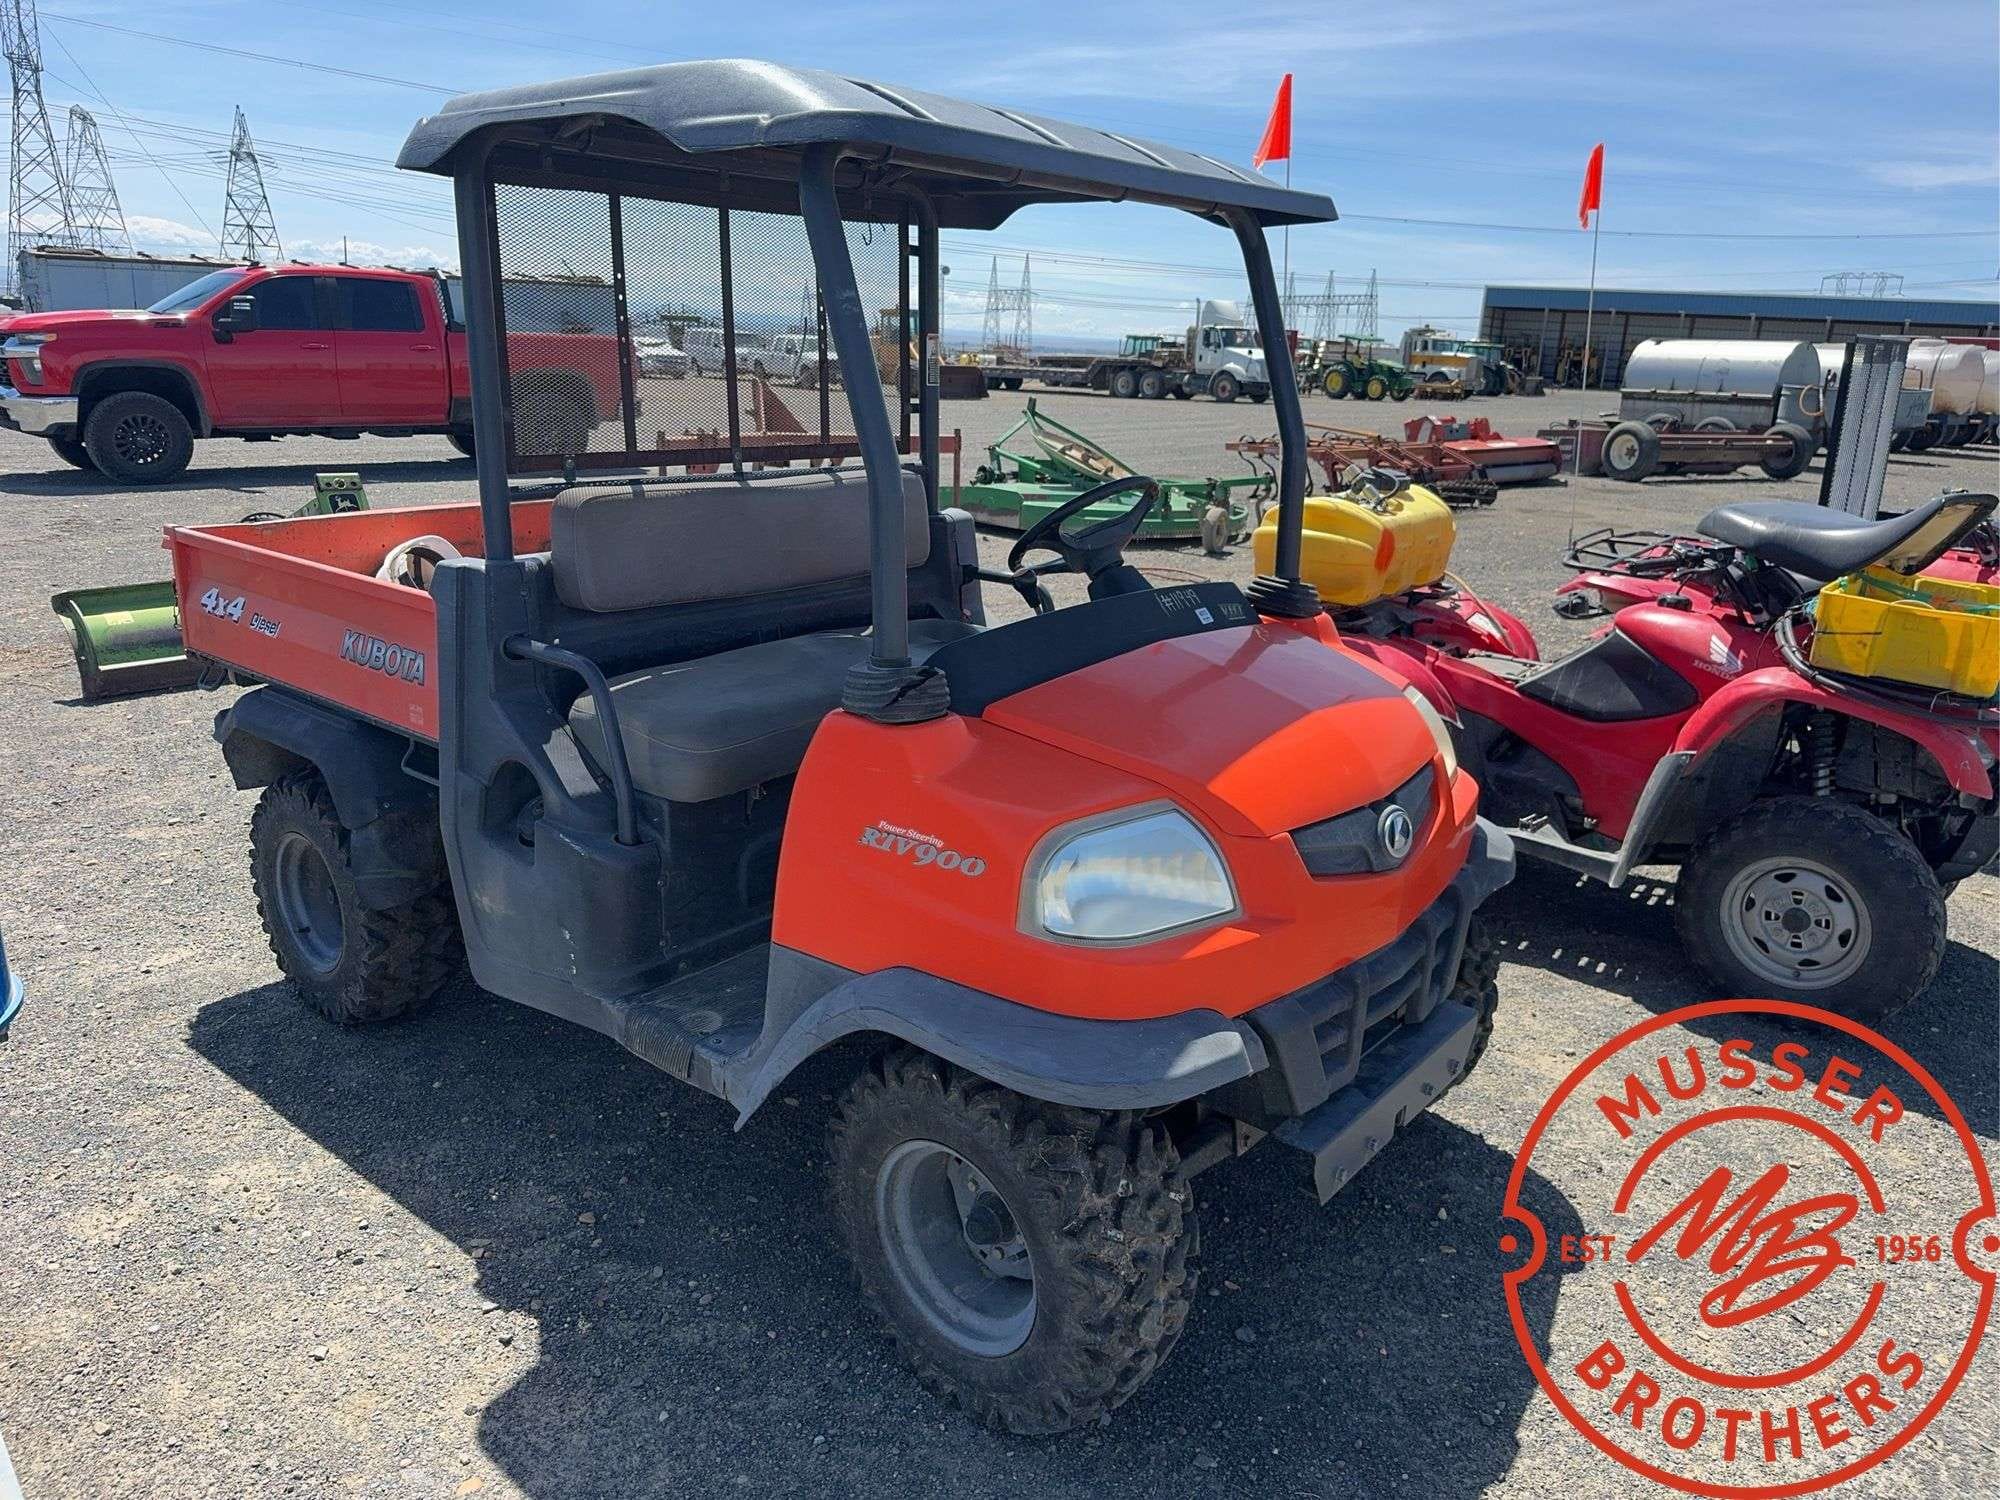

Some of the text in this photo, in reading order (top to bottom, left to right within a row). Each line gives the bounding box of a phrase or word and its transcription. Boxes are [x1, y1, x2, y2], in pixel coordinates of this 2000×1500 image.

[200, 585, 282, 639] 4x4 Diesel
[340, 628, 425, 687] KUBOTA
[858, 825, 987, 877] RTV900
[878, 820, 945, 849] Power Steering
